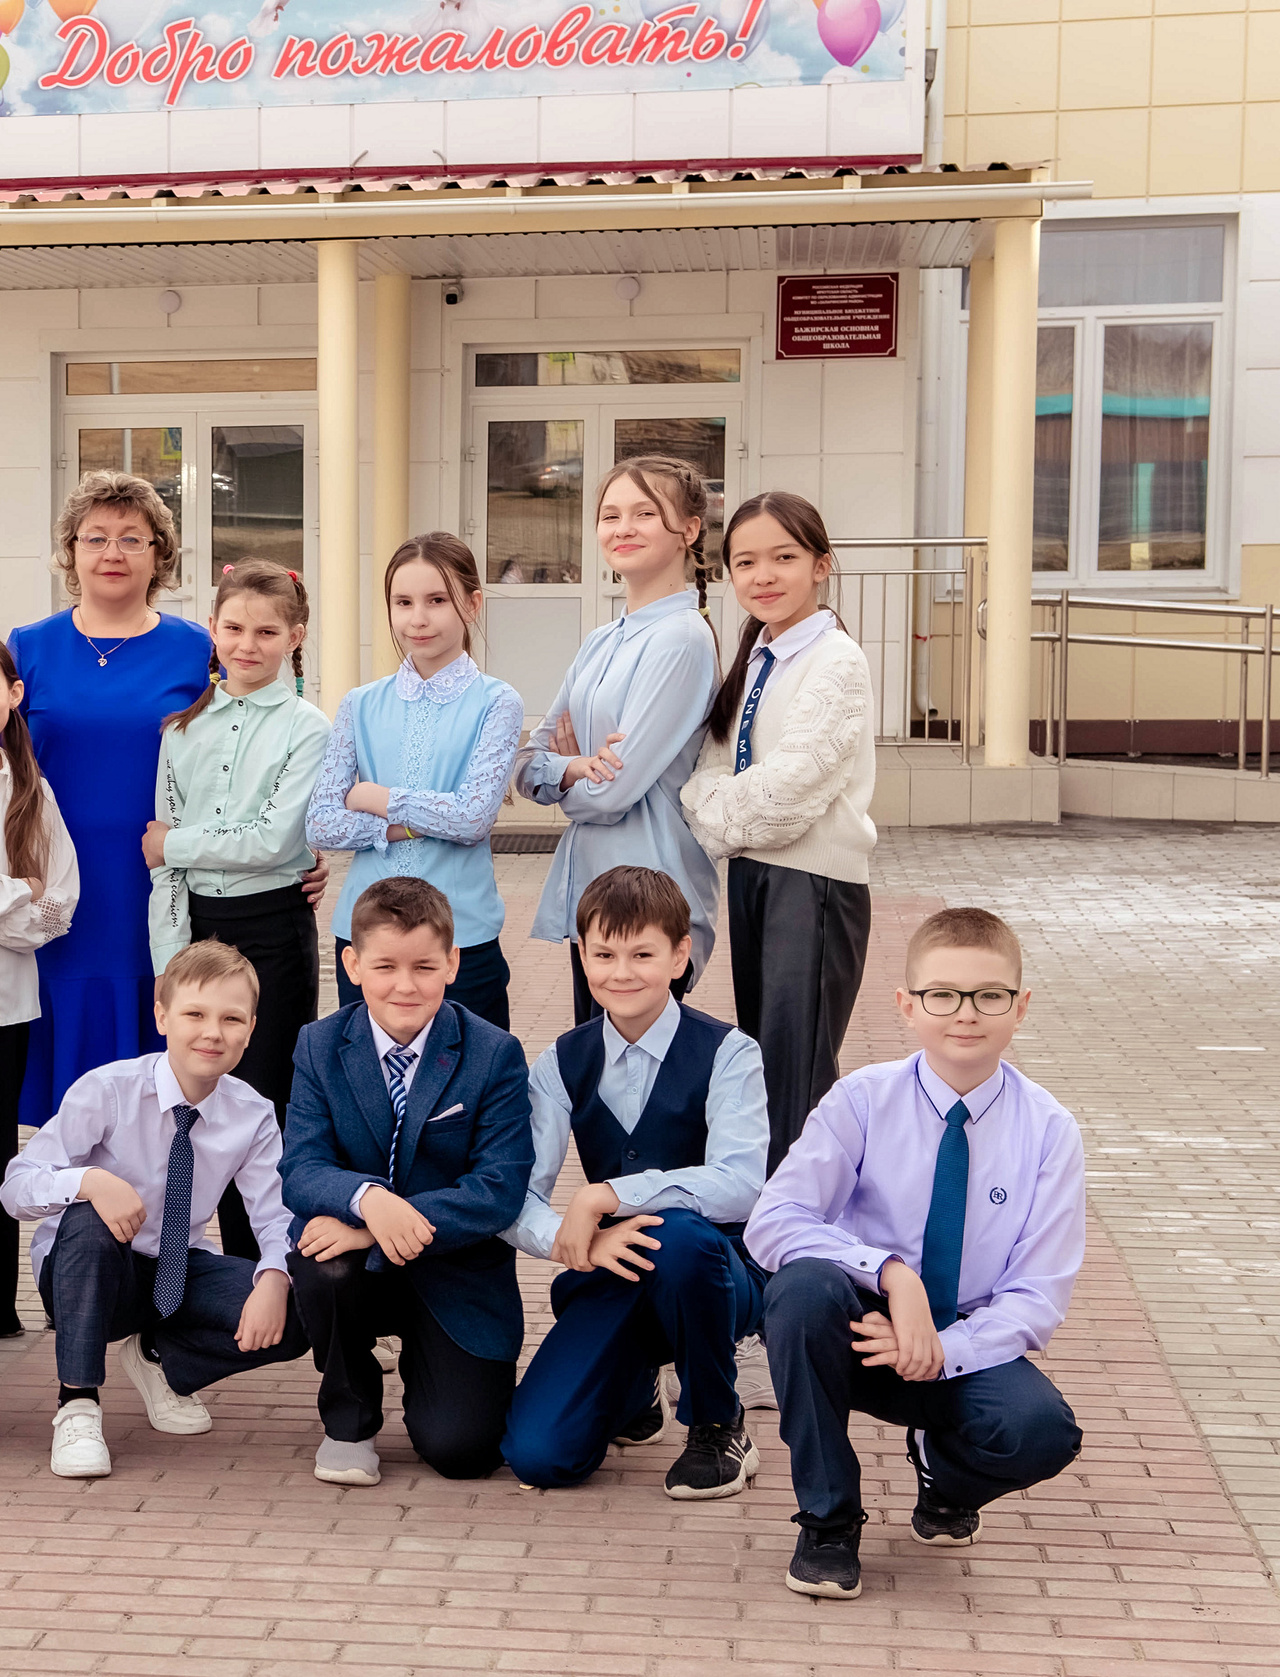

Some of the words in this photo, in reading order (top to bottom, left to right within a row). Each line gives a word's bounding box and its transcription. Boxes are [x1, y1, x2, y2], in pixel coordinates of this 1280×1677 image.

[39, 15, 254, 106] Добро
[271, 0, 763, 81] пожаловать!
[741, 688, 762, 730] ONE
